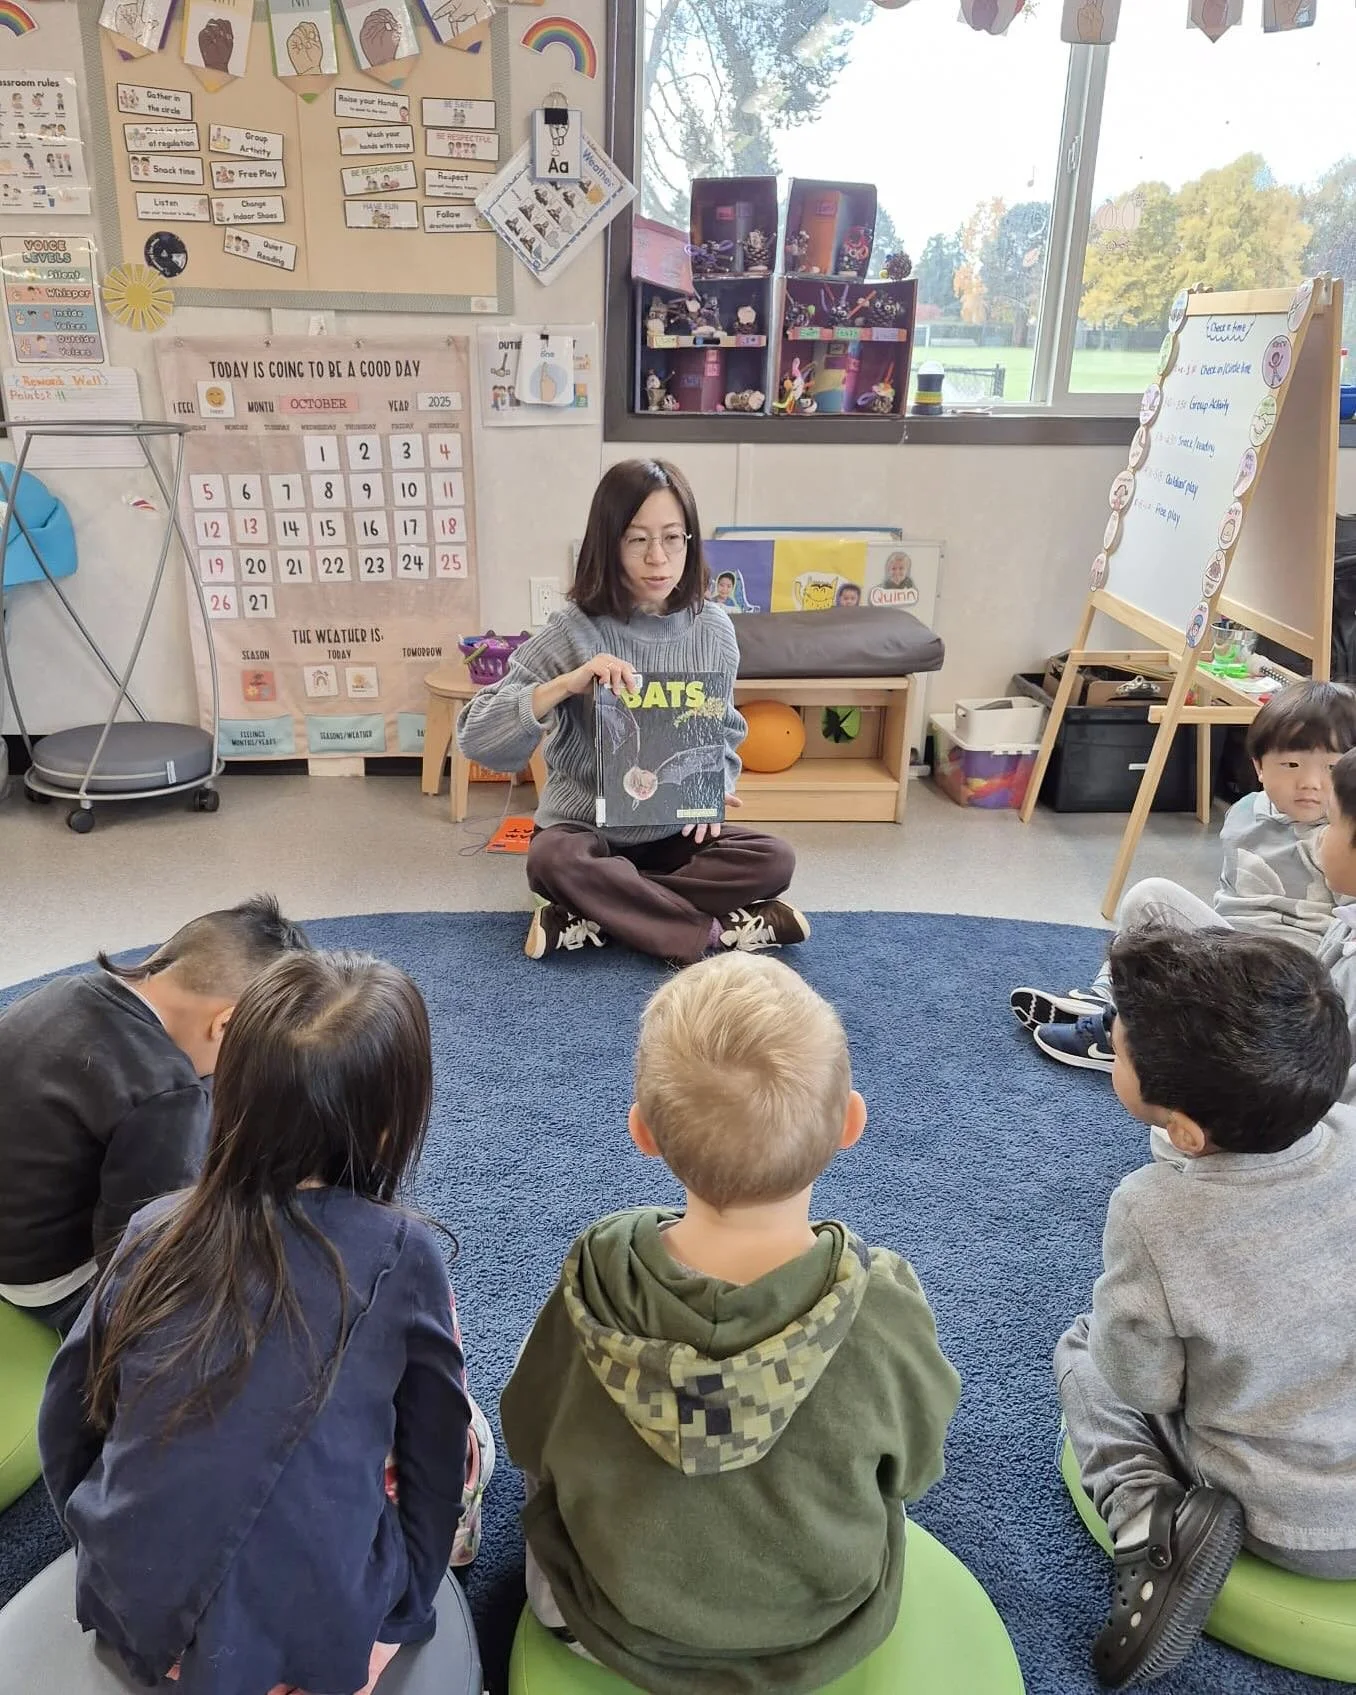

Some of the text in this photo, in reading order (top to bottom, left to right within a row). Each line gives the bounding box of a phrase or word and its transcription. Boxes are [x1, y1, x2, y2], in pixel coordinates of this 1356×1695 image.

[37, 77, 59, 87] rules
[147, 91, 172, 101] Gather
[338, 94, 358, 103] Raise
[378, 98, 399, 108] Hands
[148, 104, 181, 114] the circle
[245, 132, 269, 143] Group
[366, 130, 400, 140] Wash your
[447, 132, 493, 144] RESPECTFUL
[158, 140, 195, 149] regulation
[380, 142, 394, 150] with
[240, 145, 271, 158] Activity
[153, 165, 196, 176] Snack time
[548, 158, 569, 174] Aa
[582, 148, 615, 188] Weather
[238, 170, 277, 179] Free Play
[438, 172, 469, 183] Respect
[154, 198, 179, 207] Listen
[241, 200, 266, 209] Change
[257, 212, 278, 220] Shoes
[436, 210, 461, 219] Follow
[24, 240, 67, 252] VOICE
[264, 240, 284, 252] Quiet
[22, 252, 72, 263] LEVELS
[256, 250, 285, 267] Reading
[48, 270, 81, 279] Silent
[46, 288, 92, 299] Whisper
[54, 308, 84, 317] Inside
[55, 322, 88, 331] Voices
[498, 341, 522, 350] DUTIE
[209, 360, 421, 378] TODAY IS GOING TO BE A GOOD DAY
[248, 401, 274, 414] MONTH
[290, 398, 348, 409] OCTOBER
[388, 400, 409, 412] YEAR
[428, 396, 452, 408] 2025
[1190, 396, 1209, 414] Group
[1209, 398, 1230, 416] Activity
[178, 402, 195, 414] FEEL
[320, 442, 450, 462] 1 2 3 4
[203, 482, 454, 500] 5 6 7 8 9 10 11
[1184, 481, 1199, 500] play
[1156, 502, 1167, 517] Free
[1167, 510, 1181, 531] play
[204, 518, 456, 538] 12 13 14 15 16 17 18
[209, 554, 462, 576] 19 20 21 22 23 24 25
[873, 590, 918, 603] Quinn
[211, 594, 268, 612] 26 27
[292, 630, 312, 644] THE
[316, 629, 367, 644] WEATHER
[242, 650, 270, 661] SEASON
[328, 650, 352, 660] TODAY
[402, 647, 442, 657] TOMORROW
[620, 682, 705, 709] BATS
[320, 730, 373, 740] SEASONS/WEATHER
